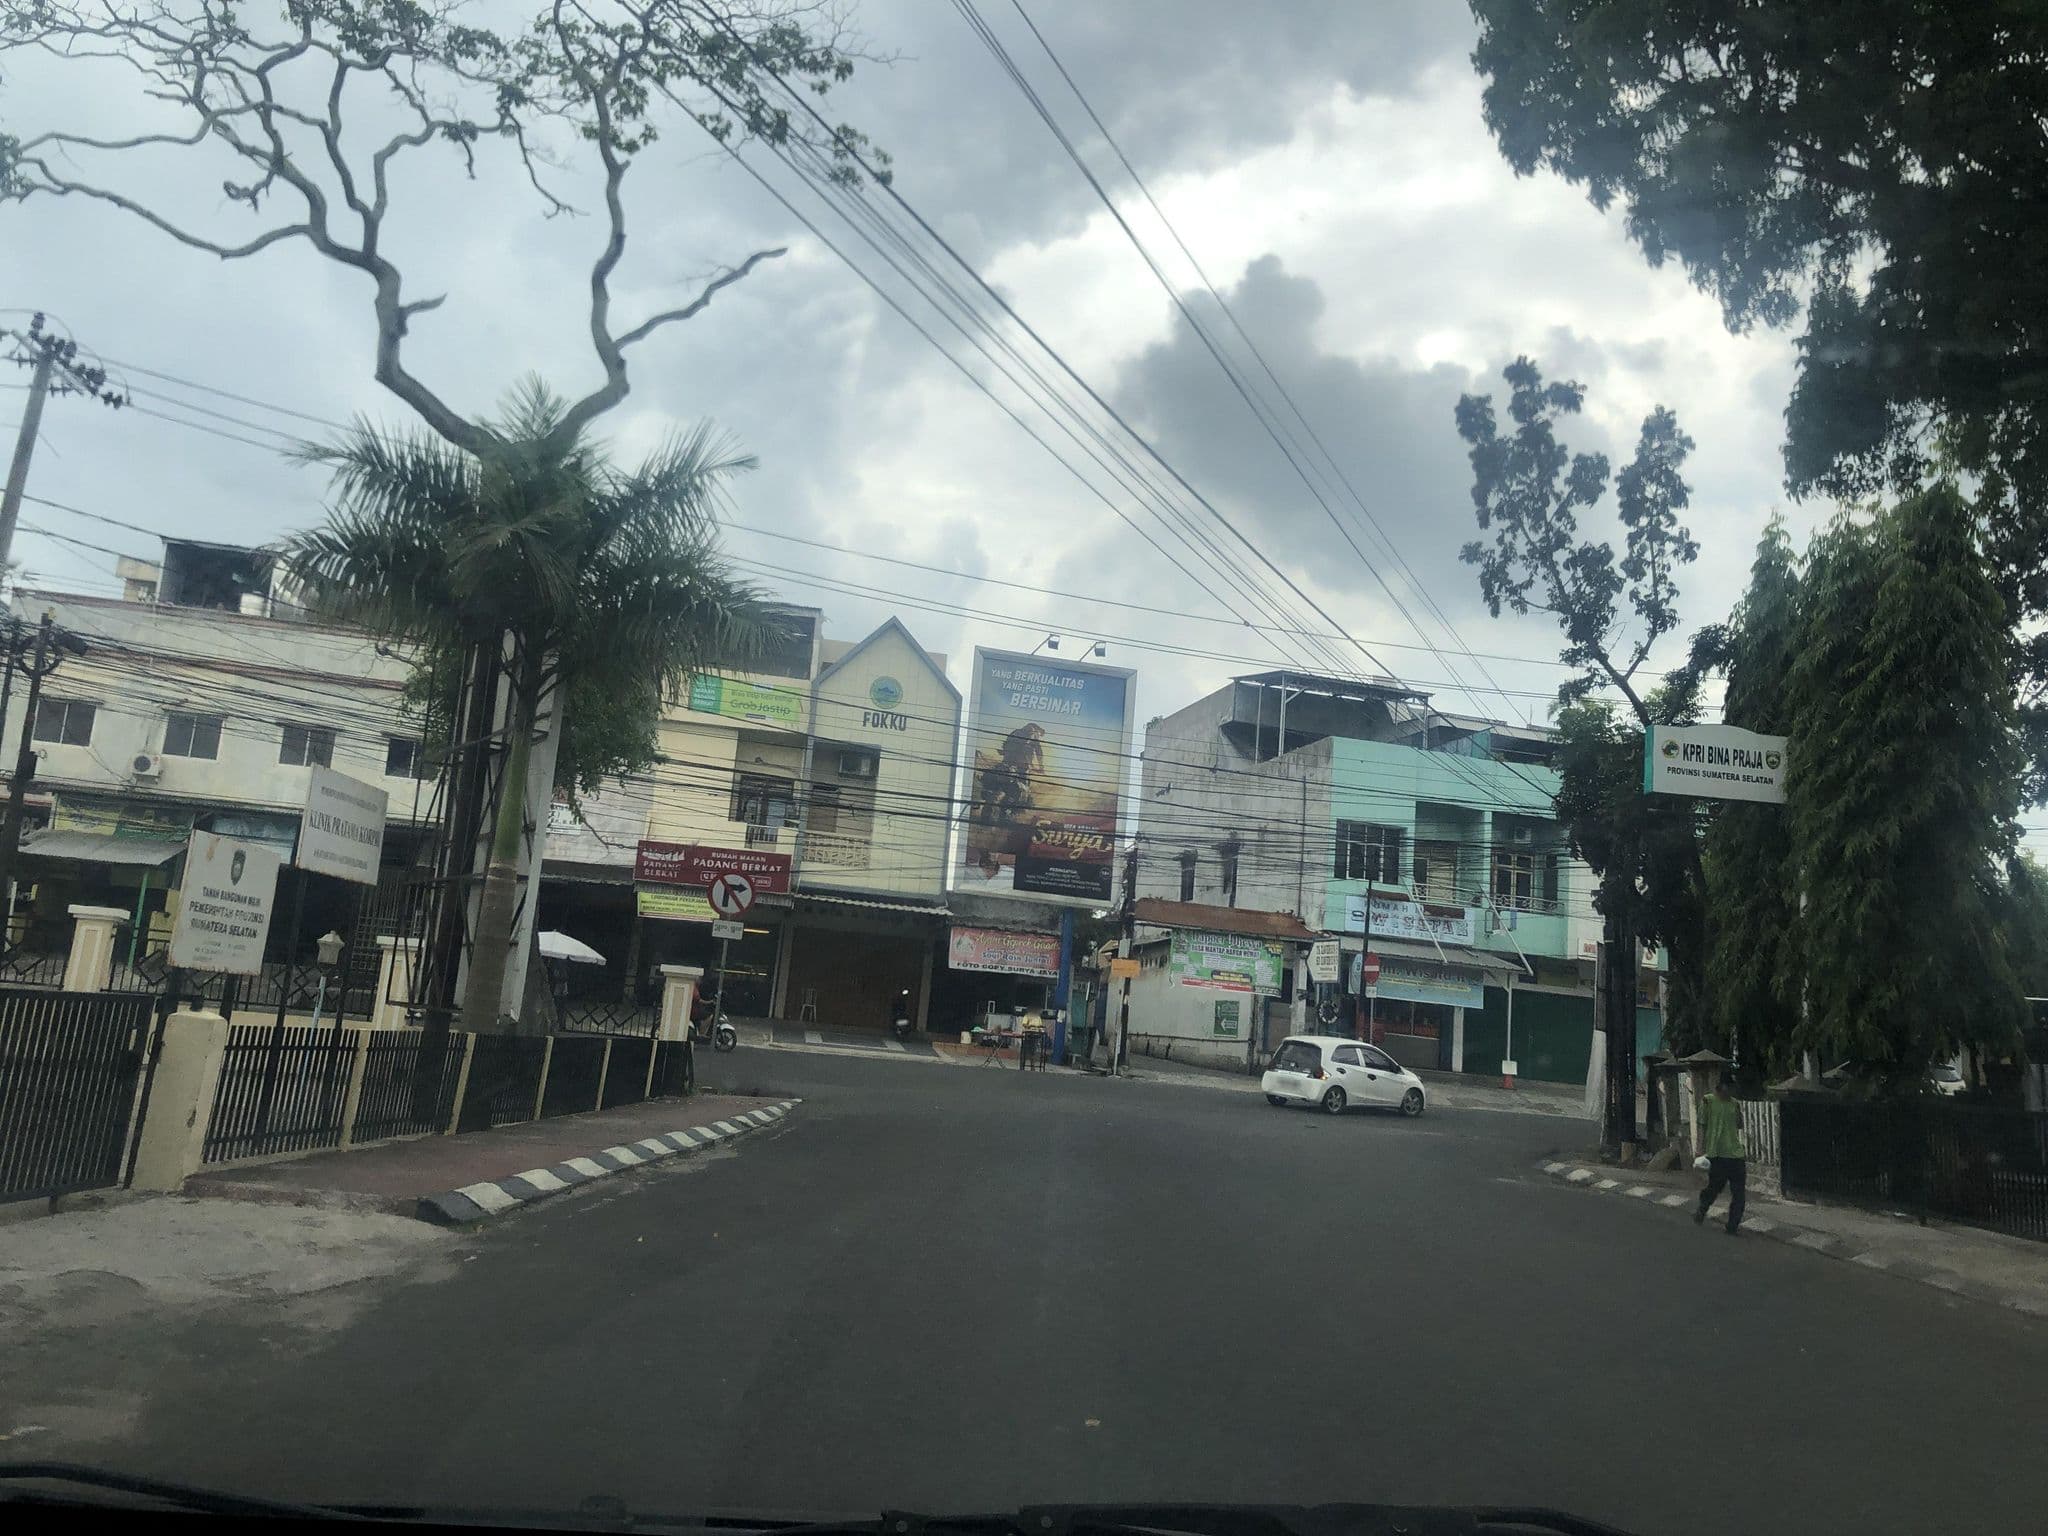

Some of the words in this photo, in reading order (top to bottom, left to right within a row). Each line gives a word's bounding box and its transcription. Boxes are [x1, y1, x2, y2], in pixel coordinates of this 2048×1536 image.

[991, 669, 1012, 679] YANG
[1014, 670, 1085, 690] BERKUALITAS
[1002, 681, 1023, 692] YANG
[1025, 684, 1049, 695] PASTI
[1010, 693, 1082, 716] BERSINAR
[863, 711, 907, 731] FOKKU
[1682, 743, 1705, 763] KPRI
[1708, 745, 1730, 766] BINA
[1732, 748, 1763, 769] PRAJA
[1667, 766, 1700, 777] PROVINSI
[1702, 770, 1740, 781] SUMATERA
[1742, 774, 1774, 785] SELATAN
[693, 858, 738, 870] PADANG
[741, 863, 783, 873] BERKAT
[228, 924, 258, 939] SELATAN
[982, 963, 1005, 971] COPY
